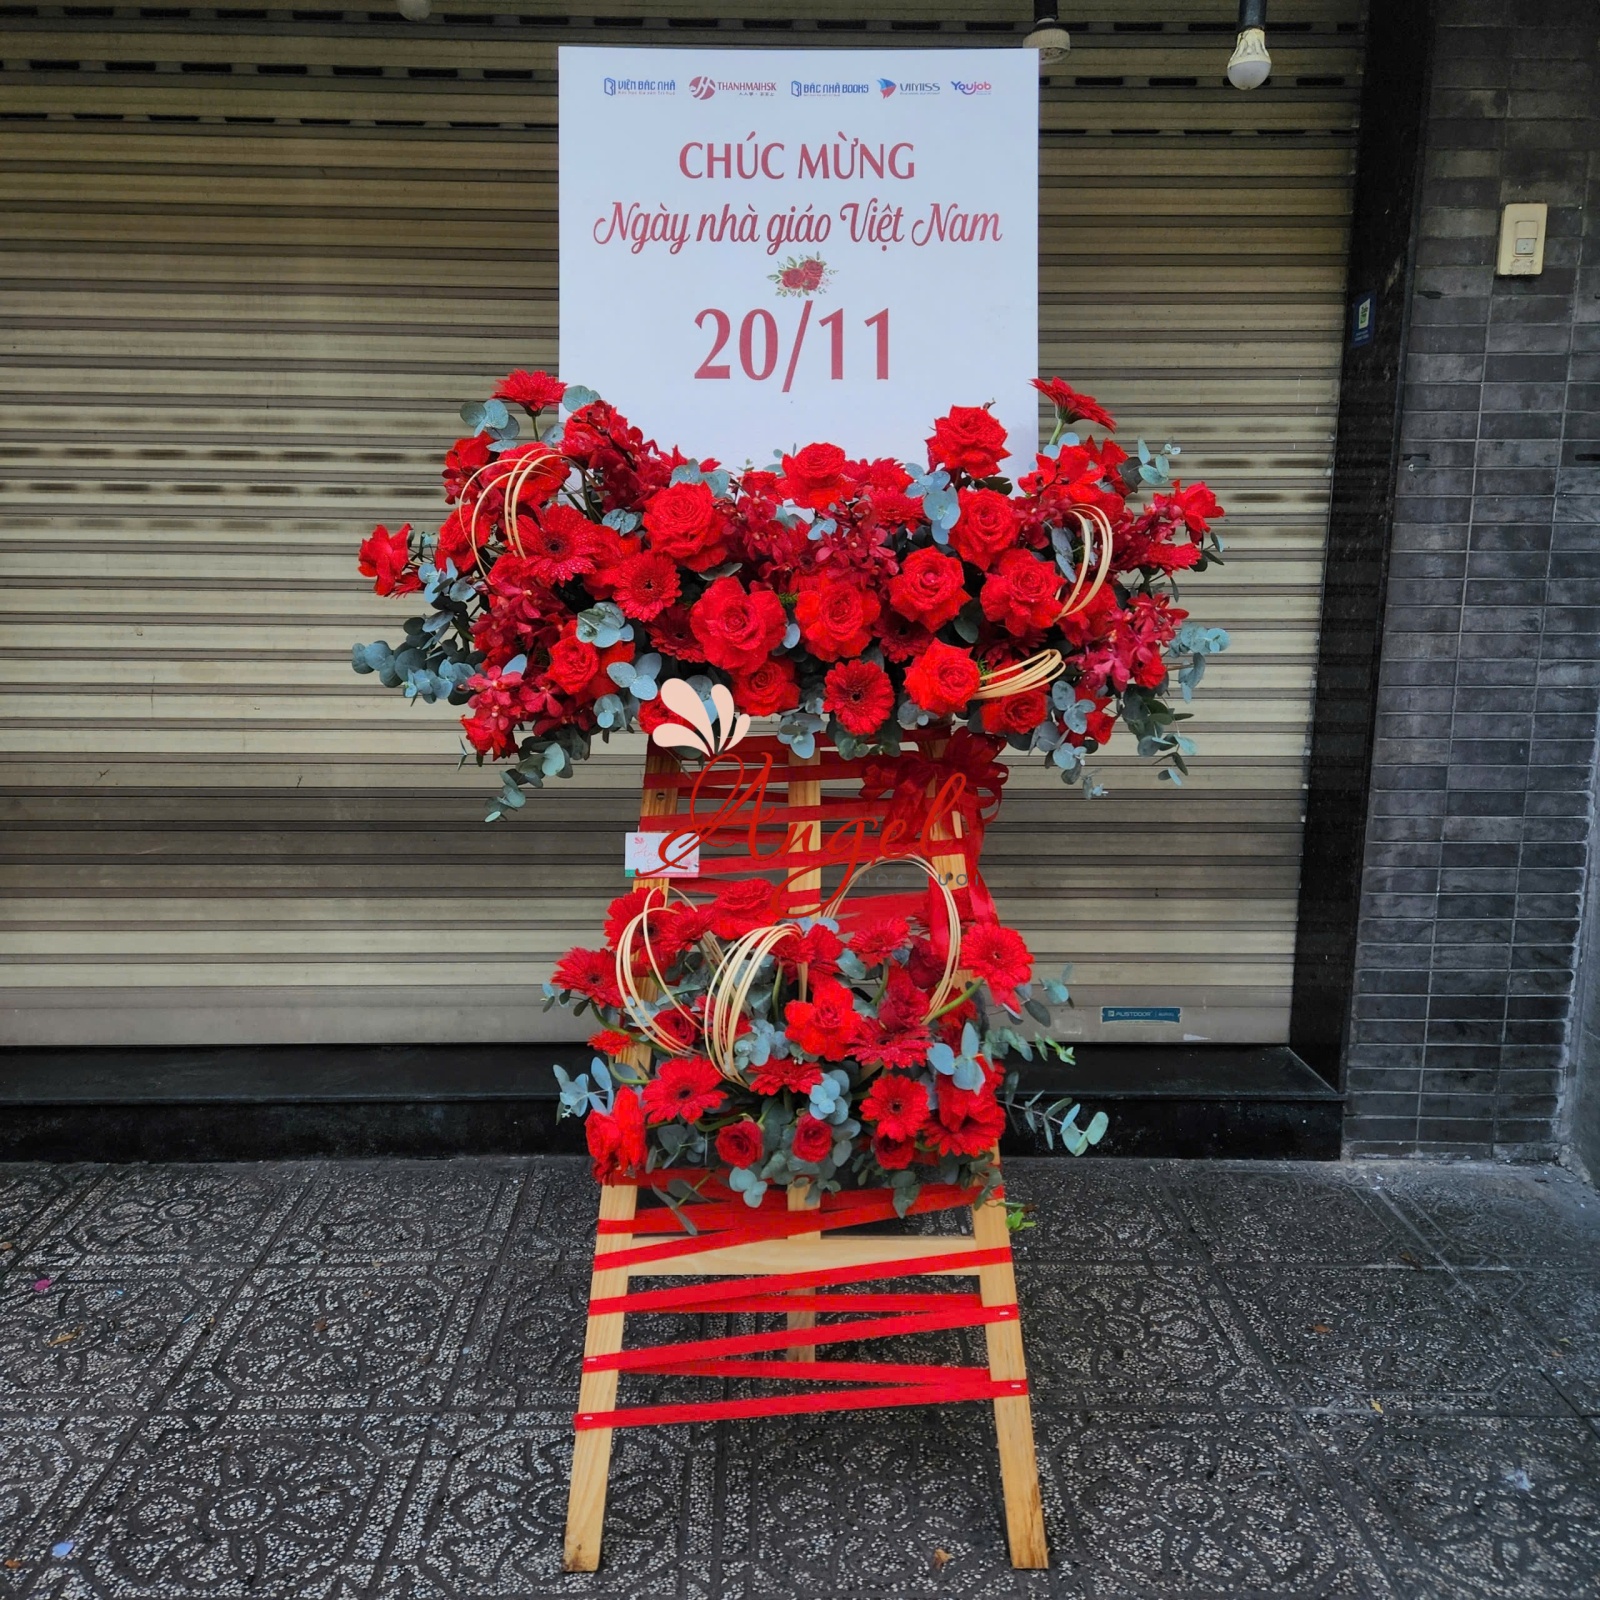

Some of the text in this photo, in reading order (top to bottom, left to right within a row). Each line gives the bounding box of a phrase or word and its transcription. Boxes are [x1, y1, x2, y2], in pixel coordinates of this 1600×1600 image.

[717, 81, 777, 91] THANHMAIHSK
[842, 83, 869, 94] BOOKS
[951, 81, 992, 95] Youjob
[679, 131, 915, 180] CHÚC MỪNG
[593, 197, 1003, 256] Ngày nhà giáo Việt Nam
[693, 300, 889, 393] 20/11
